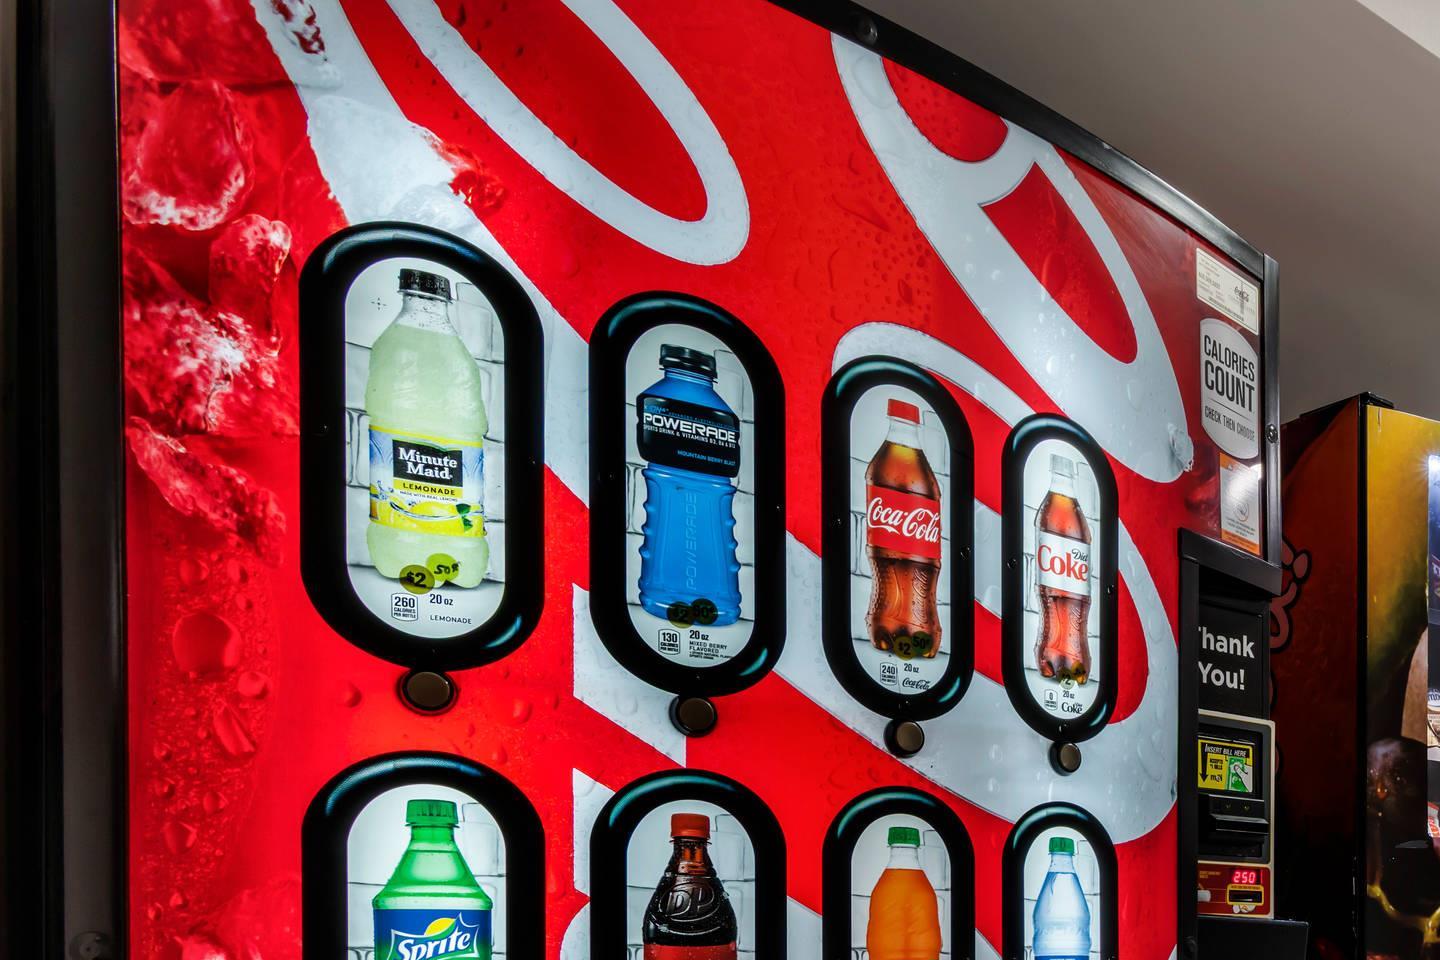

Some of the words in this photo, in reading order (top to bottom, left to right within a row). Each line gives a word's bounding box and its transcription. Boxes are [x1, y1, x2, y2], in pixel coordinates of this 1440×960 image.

[1203, 334, 1255, 382] CALORIES
[1204, 359, 1255, 412] COUNT
[1204, 405, 1222, 424] CHECK
[1222, 414, 1236, 432] THEN
[643, 412, 737, 443] POWERADE
[659, 426, 675, 436] DRINK
[682, 432, 708, 443] VITAMINS
[398, 446, 458, 468] Minute
[406, 460, 452, 480] Maid
[402, 482, 456, 496] LEMONADE
[867, 496, 940, 543] Coca-Cola
[1071, 547, 1089, 562] Diet
[1037, 544, 1089, 582] Coke
[406, 570, 427, 588] $2
[394, 596, 415, 609] 260
[429, 593, 442, 605] 20
[430, 614, 472, 624] LEMONADE
[661, 632, 678, 643] 130
[689, 629, 700, 640] 20
[708, 642, 728, 650] BERRY
[1198, 626, 1255, 659] hank
[689, 646, 719, 654] FLAVORED
[881, 664, 896, 675] 240
[903, 662, 912, 673] 20
[1198, 660, 1245, 691] You!
[902, 677, 931, 690] Coca-Cola
[1205, 743, 1222, 753] INSERT
[1233, 871, 1256, 884] 250
